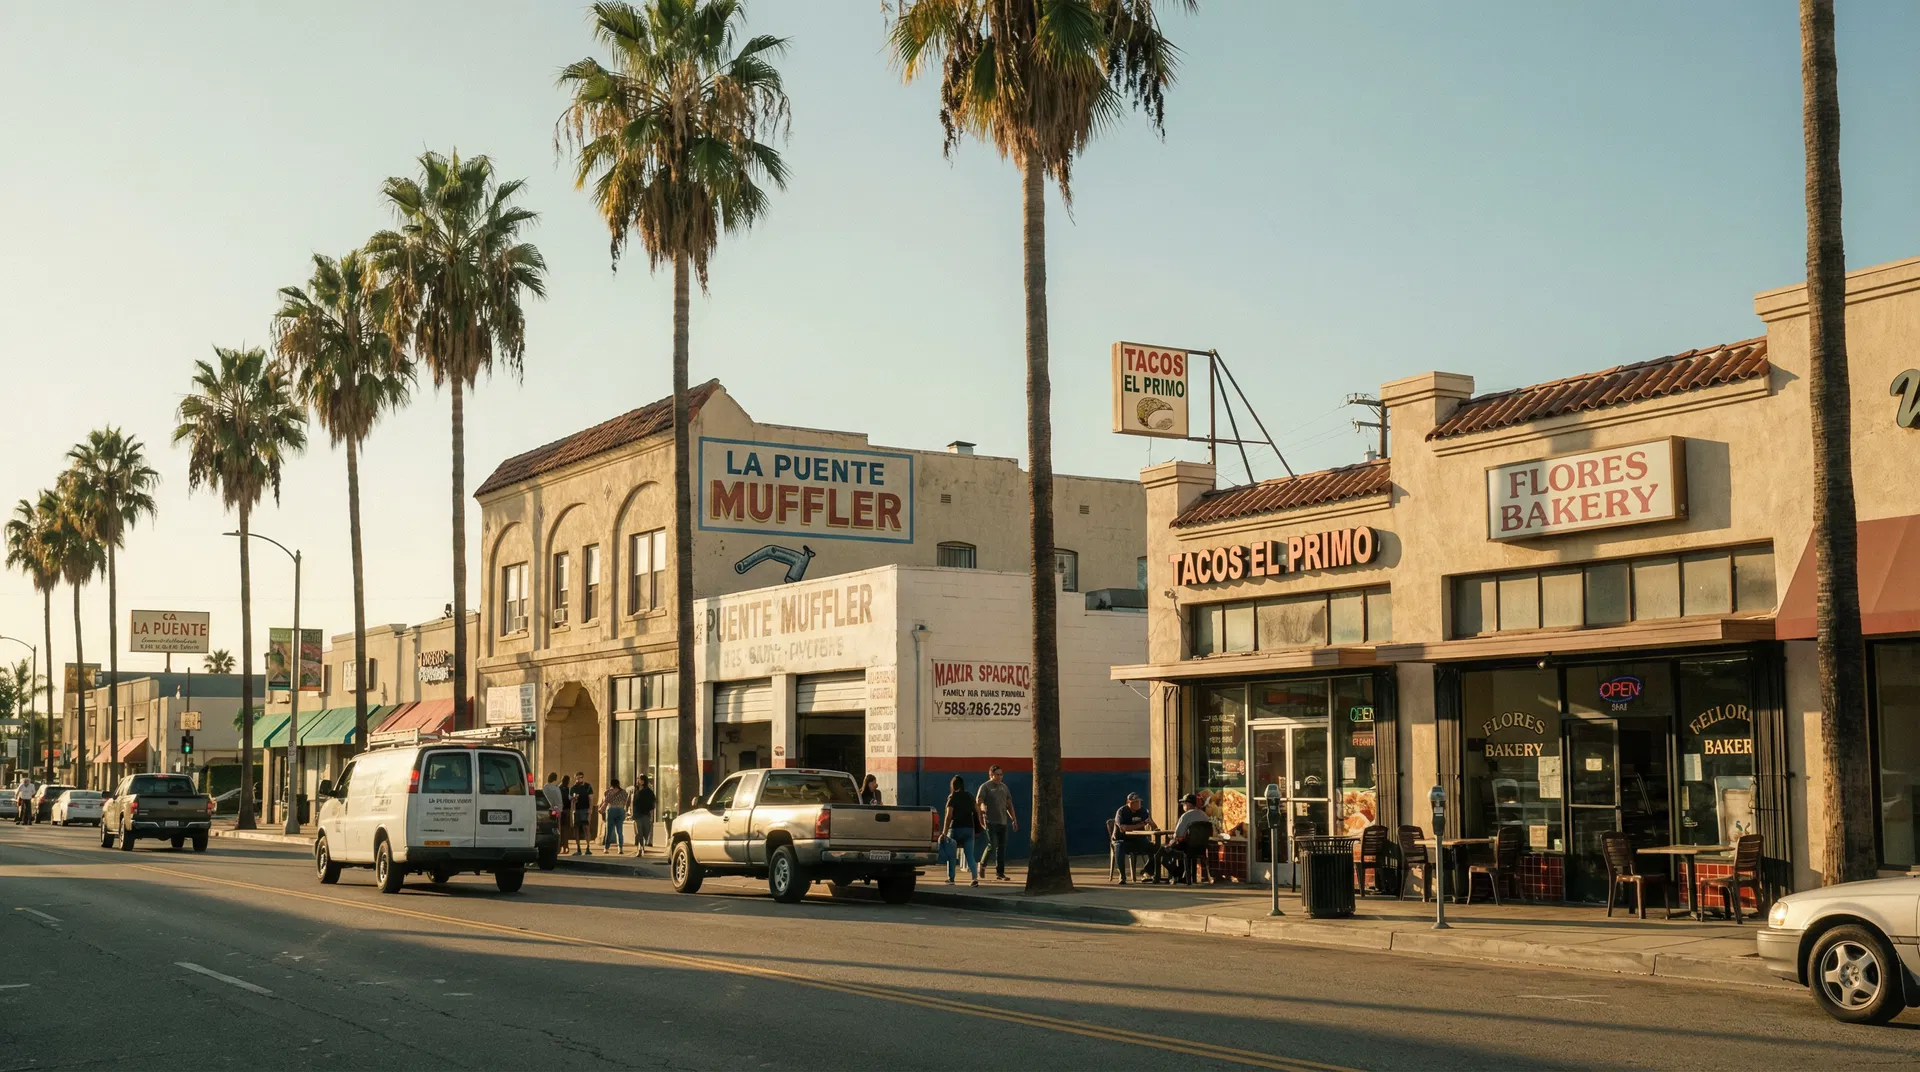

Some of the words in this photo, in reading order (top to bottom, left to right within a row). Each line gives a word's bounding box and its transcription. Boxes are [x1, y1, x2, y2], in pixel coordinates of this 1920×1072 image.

[1124, 347, 1184, 377] TACOS
[1124, 374, 1140, 393] EL
[1143, 376, 1185, 398] PRIMO
[726, 450, 764, 477] LA
[774, 454, 885, 486] PUENTE
[1509, 451, 1648, 499] FLORES
[709, 479, 902, 532] MUFFLER
[1501, 483, 1659, 532] BAKERY
[1168, 544, 1244, 587] TACOS
[1250, 539, 1280, 577] EL
[1287, 525, 1374, 573] PRIMO
[133, 621, 149, 635] LA
[153, 622, 207, 637] PUENTE
[706, 599, 772, 645] PUENTE
[780, 583, 873, 635] MUFFLER
[1600, 681, 1641, 698] OPEN
[1482, 711, 1546, 738] FLORES
[1485, 742, 1545, 758] BAKERY
